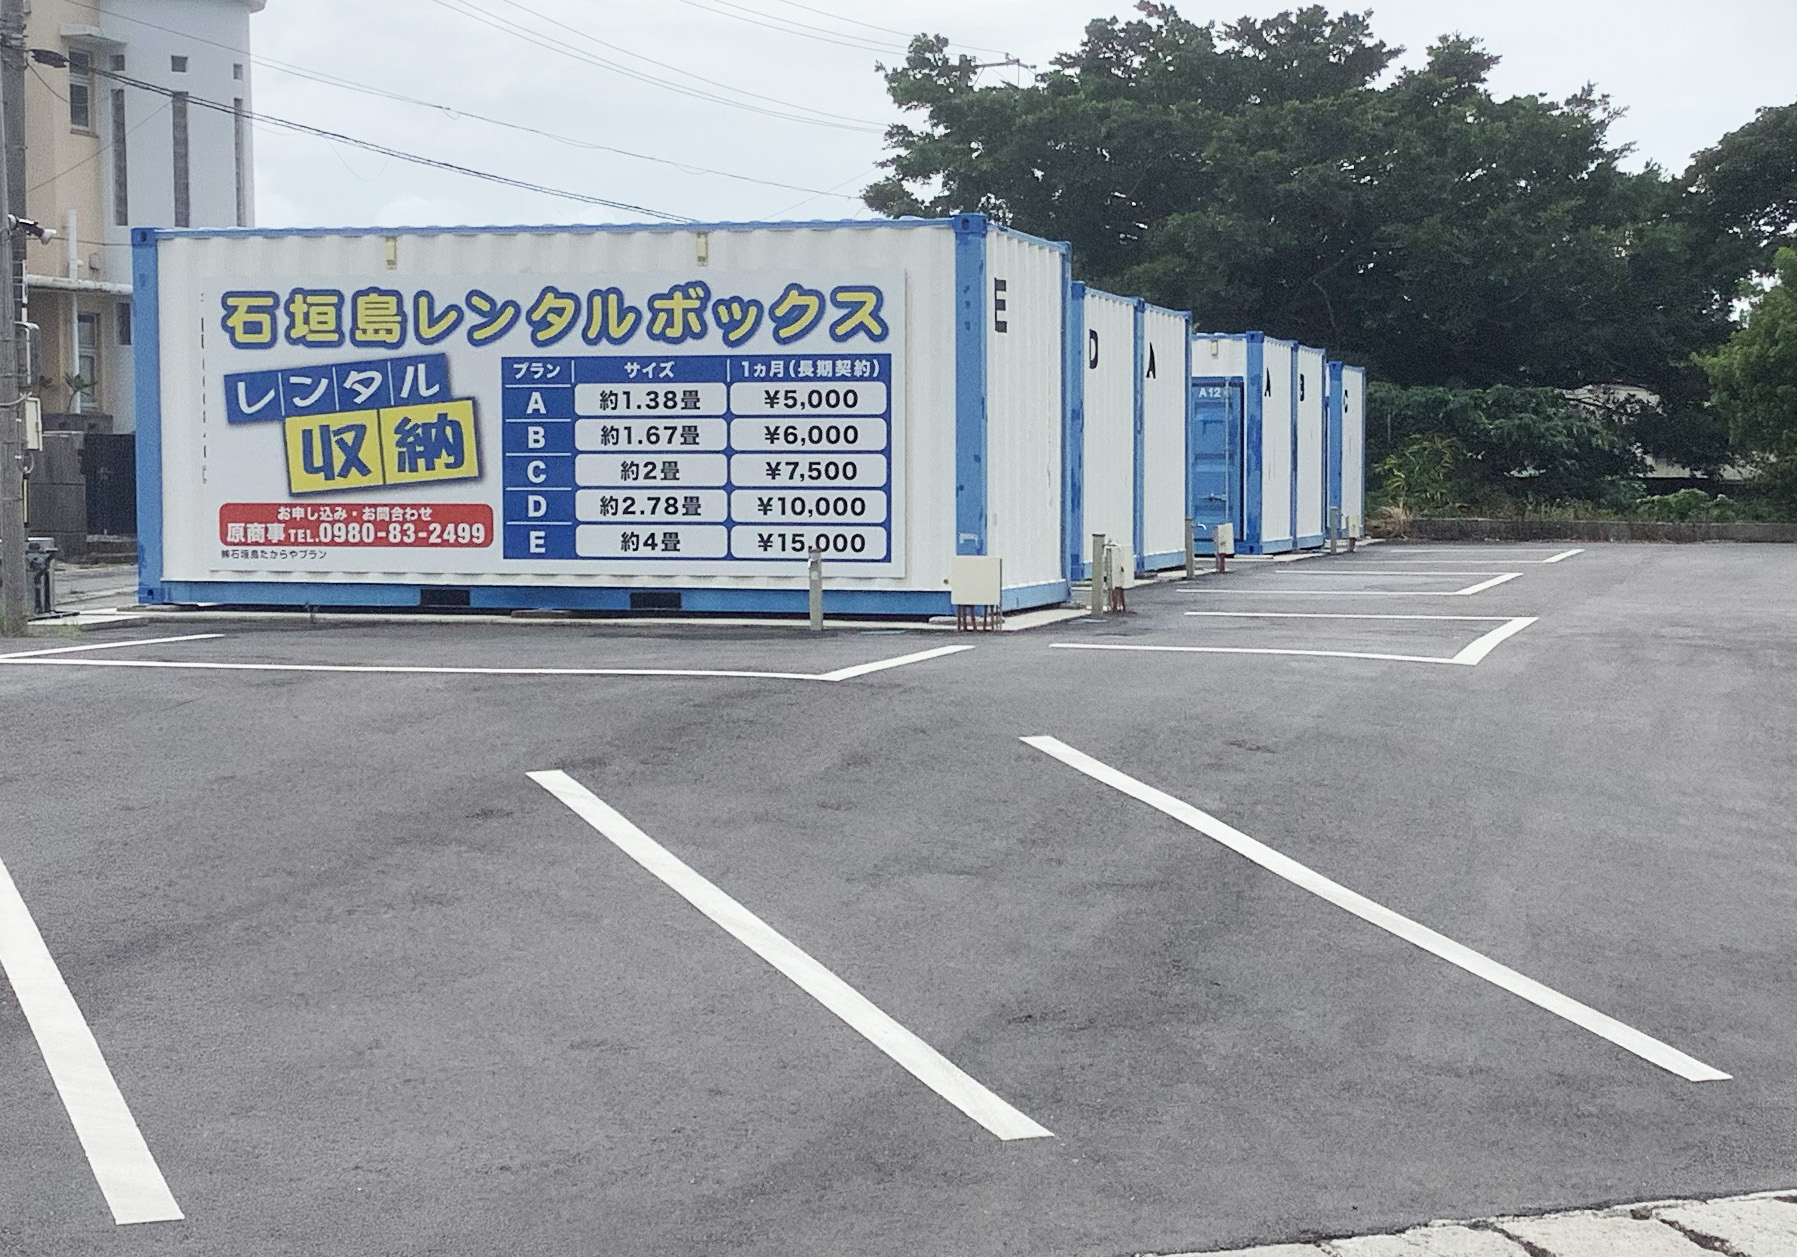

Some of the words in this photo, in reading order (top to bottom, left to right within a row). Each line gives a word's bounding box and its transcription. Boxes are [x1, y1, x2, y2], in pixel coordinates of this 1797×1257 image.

[221, 279, 889, 349] 石垣島レンタルボックス
[994, 278, 1007, 333] E
[1089, 329, 1098, 369] D
[624, 361, 675, 379] サイズ
[1146, 342, 1156, 379] A
[236, 363, 440, 414] レンタル
[1264, 367, 1271, 397] A
[526, 392, 546, 414] A
[599, 390, 701, 411] 約1.38畳
[764, 389, 859, 410] ¥5,000
[301, 413, 464, 480] 収納
[527, 426, 545, 448] B
[600, 425, 700, 446] 約1.67畳
[764, 425, 859, 447] ¥6,000
[527, 460, 546, 483] C
[620, 461, 680, 481] 約2畳
[765, 461, 858, 482] ¥7,500
[277, 506, 432, 521] お申し込み・お問合わせ
[528, 495, 546, 518] D
[599, 496, 702, 517] 約2.78畳
[757, 497, 866, 519] ¥10,000
[226, 522, 286, 543] 原商事
[529, 531, 545, 553] E
[620, 532, 681, 552] 約4畳
